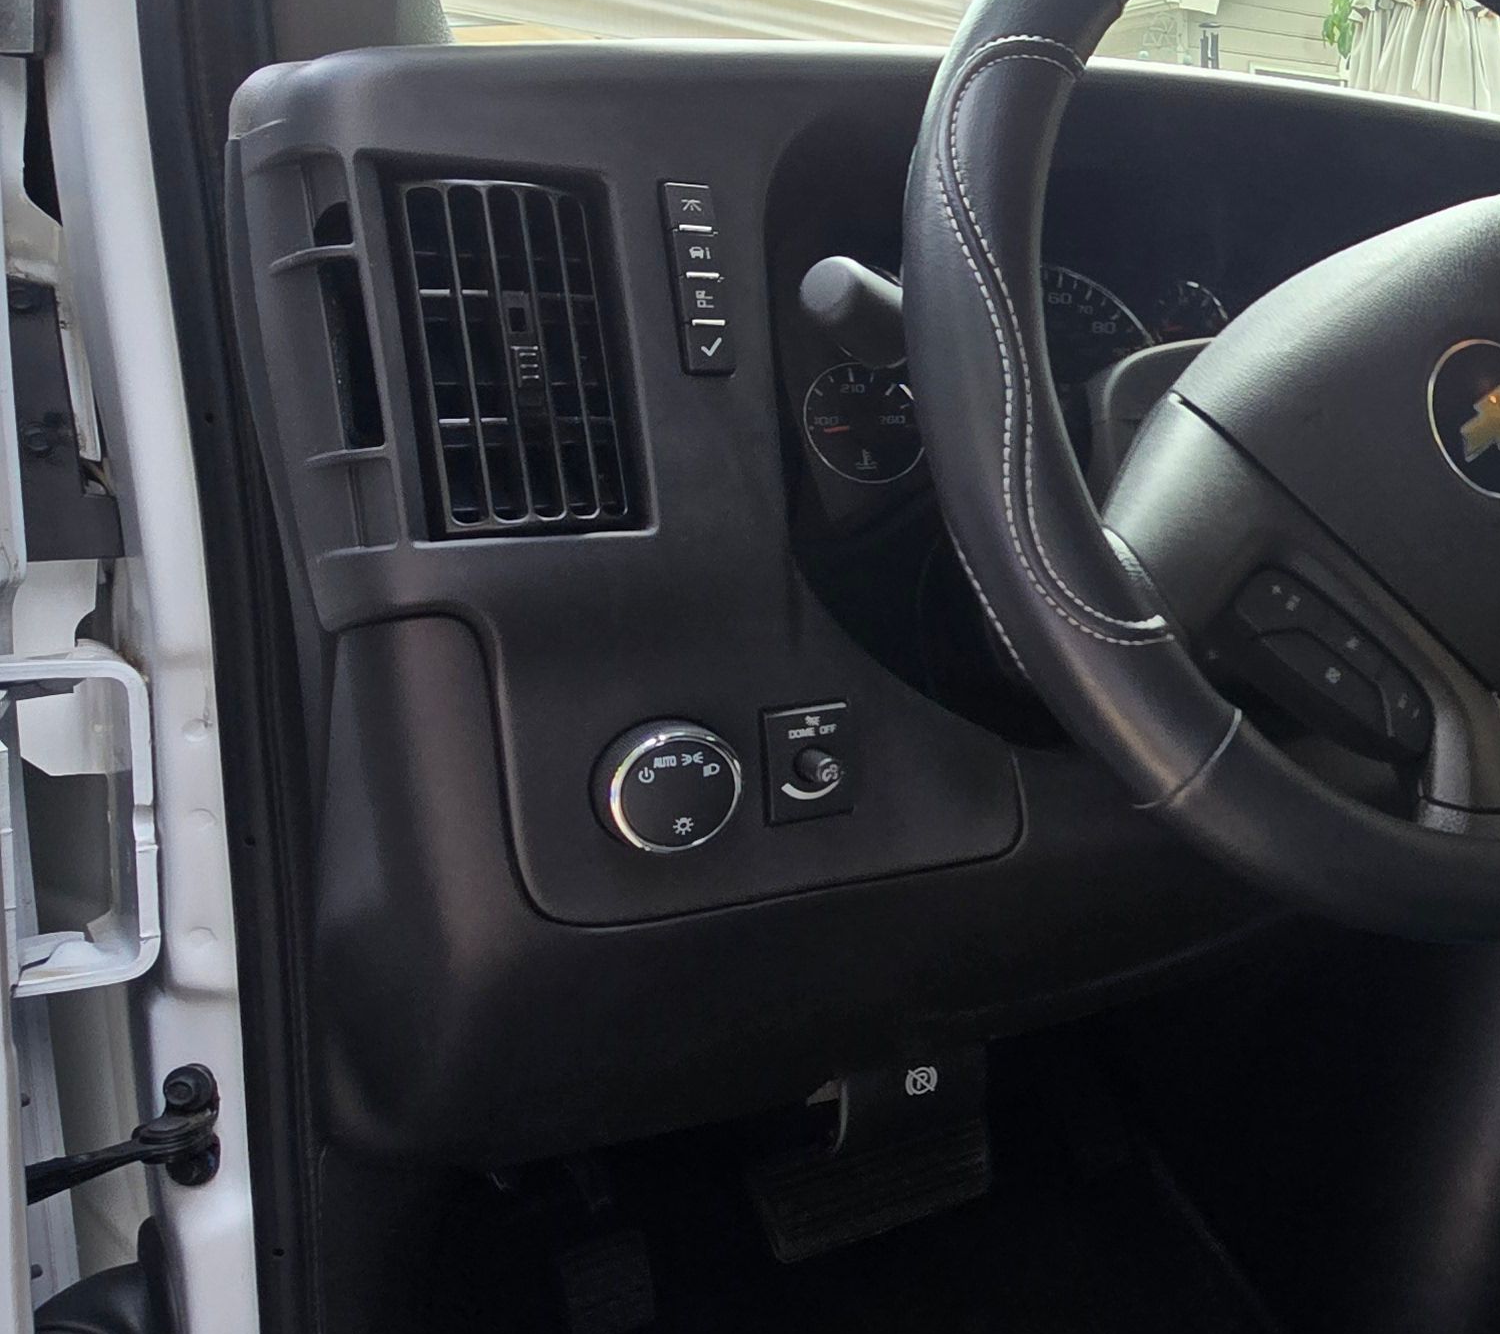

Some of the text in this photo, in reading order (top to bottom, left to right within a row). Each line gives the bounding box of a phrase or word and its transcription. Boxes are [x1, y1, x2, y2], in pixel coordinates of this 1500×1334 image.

[1047, 292, 1073, 305] 60
[840, 383, 865, 394] 210
[788, 723, 838, 740] DOME OFF
[653, 754, 677, 769] AUTO
